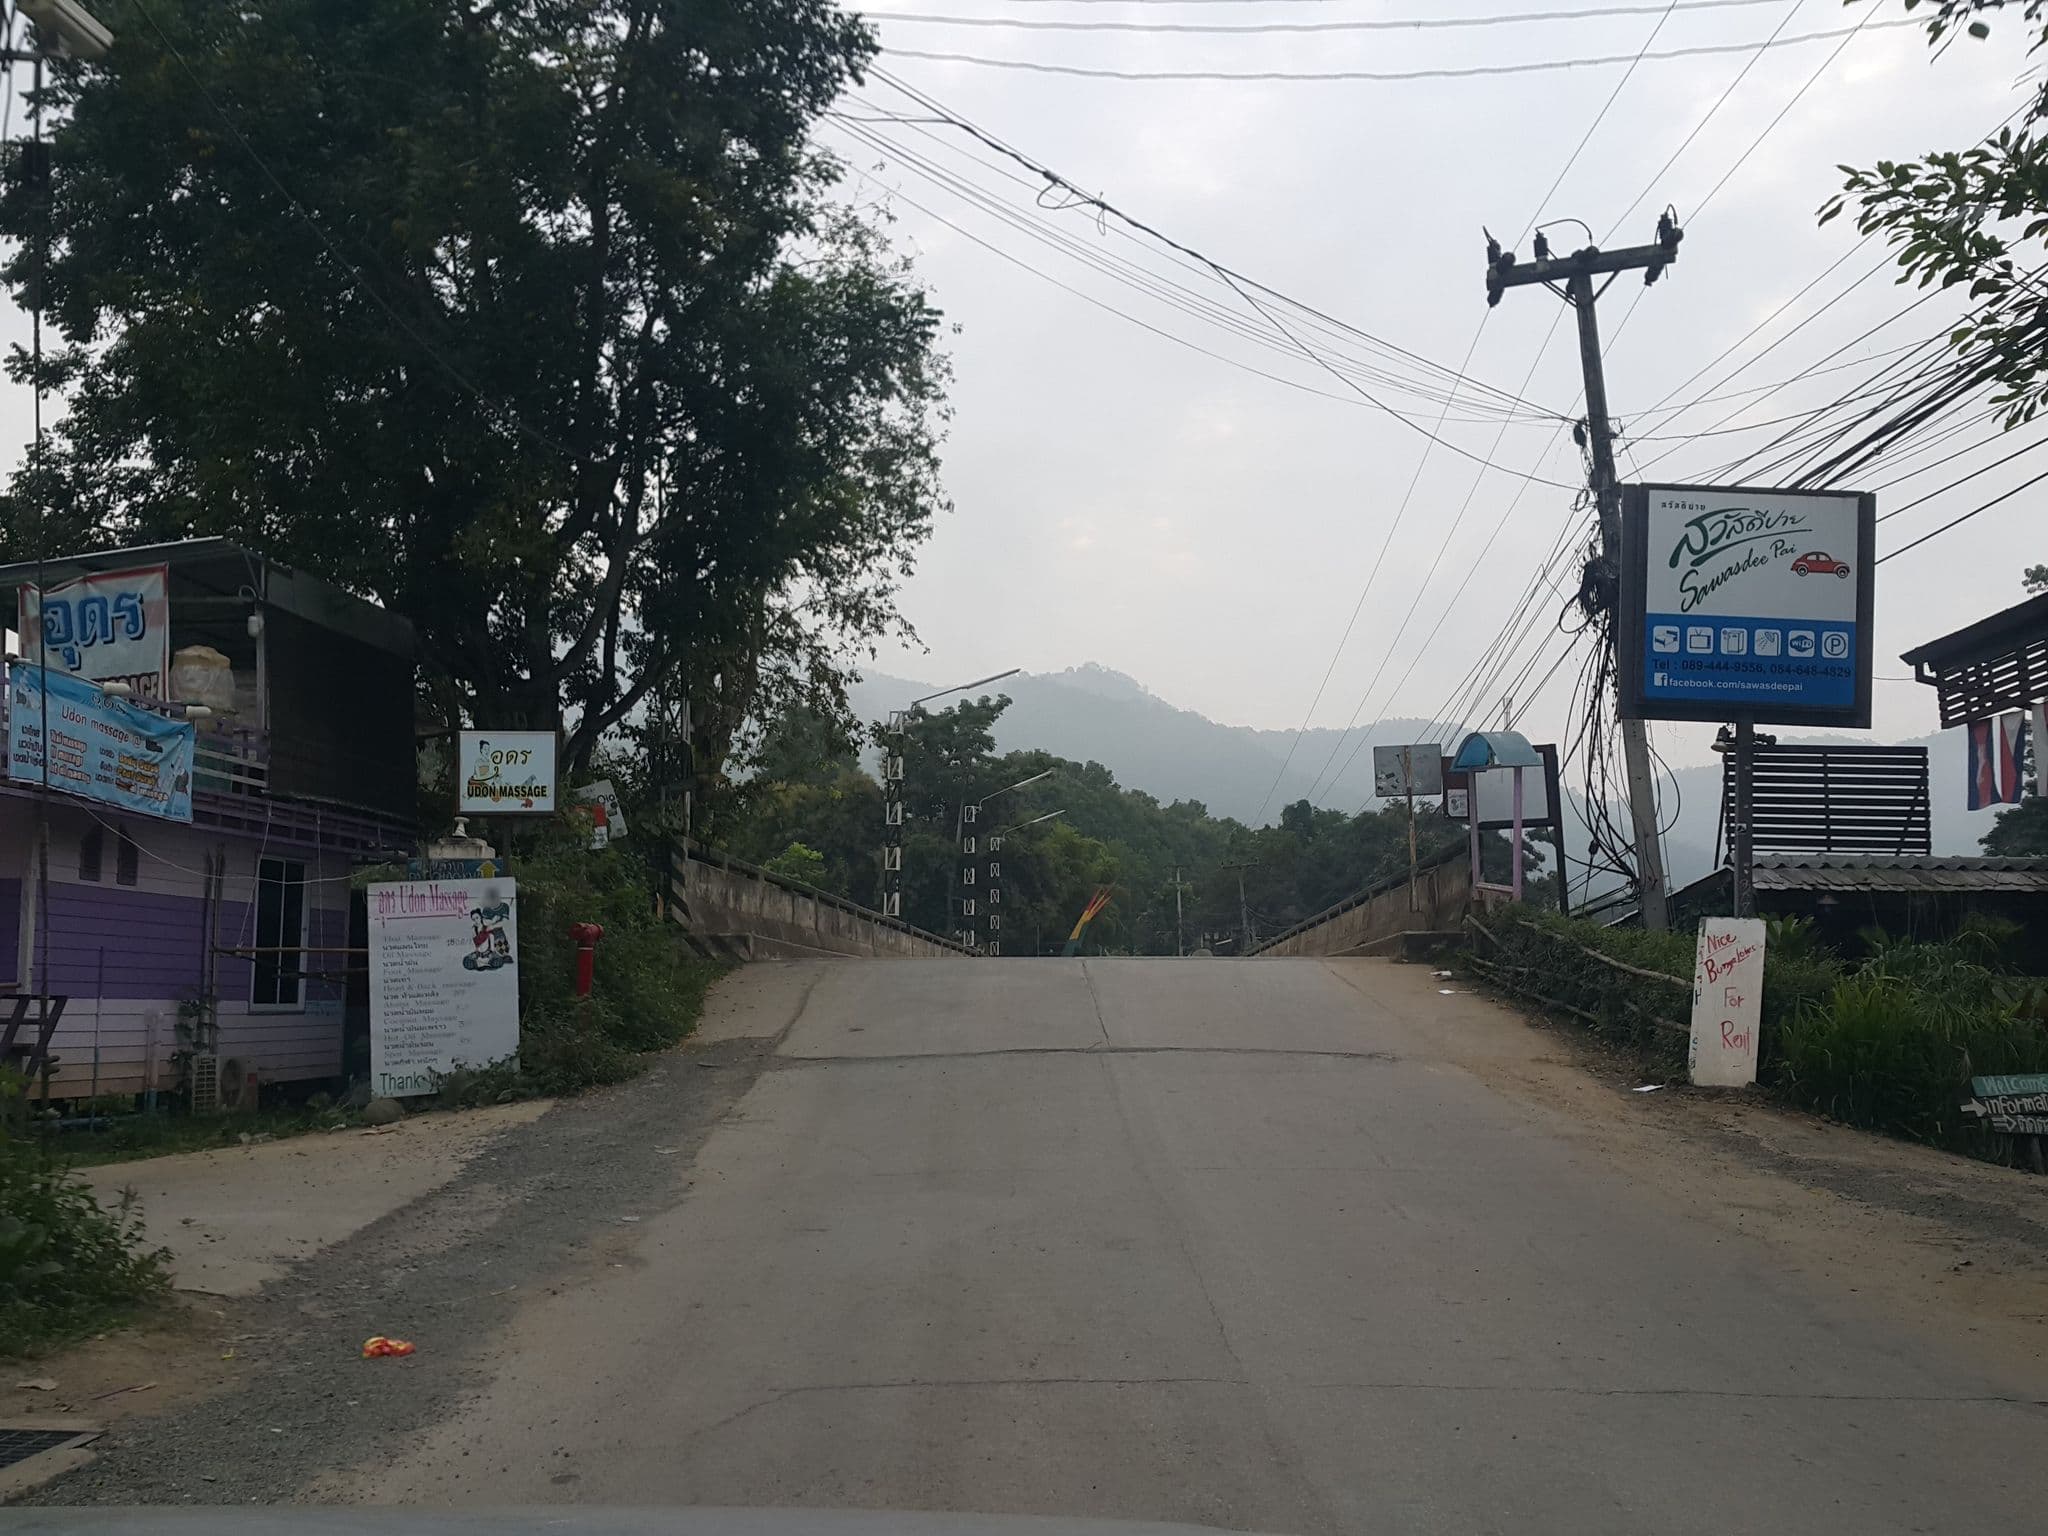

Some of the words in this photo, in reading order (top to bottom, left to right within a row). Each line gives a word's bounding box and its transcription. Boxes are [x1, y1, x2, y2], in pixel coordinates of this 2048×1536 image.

[1680, 548, 1769, 613] Sawasdee
[1770, 539, 1797, 559] Pai
[43, 592, 145, 671] อุดร
[1669, 677, 1803, 692] facebook.com/sawasdeepai
[61, 704, 87, 726] Udon
[485, 749, 532, 779] อุดร
[467, 785, 496, 797] UDON
[499, 785, 547, 797] MASSAGE
[1707, 933, 1737, 954] Nice
[1724, 987, 1745, 1008] For
[1720, 1020, 1752, 1056] Rent
[379, 1071, 423, 1091] Thank
